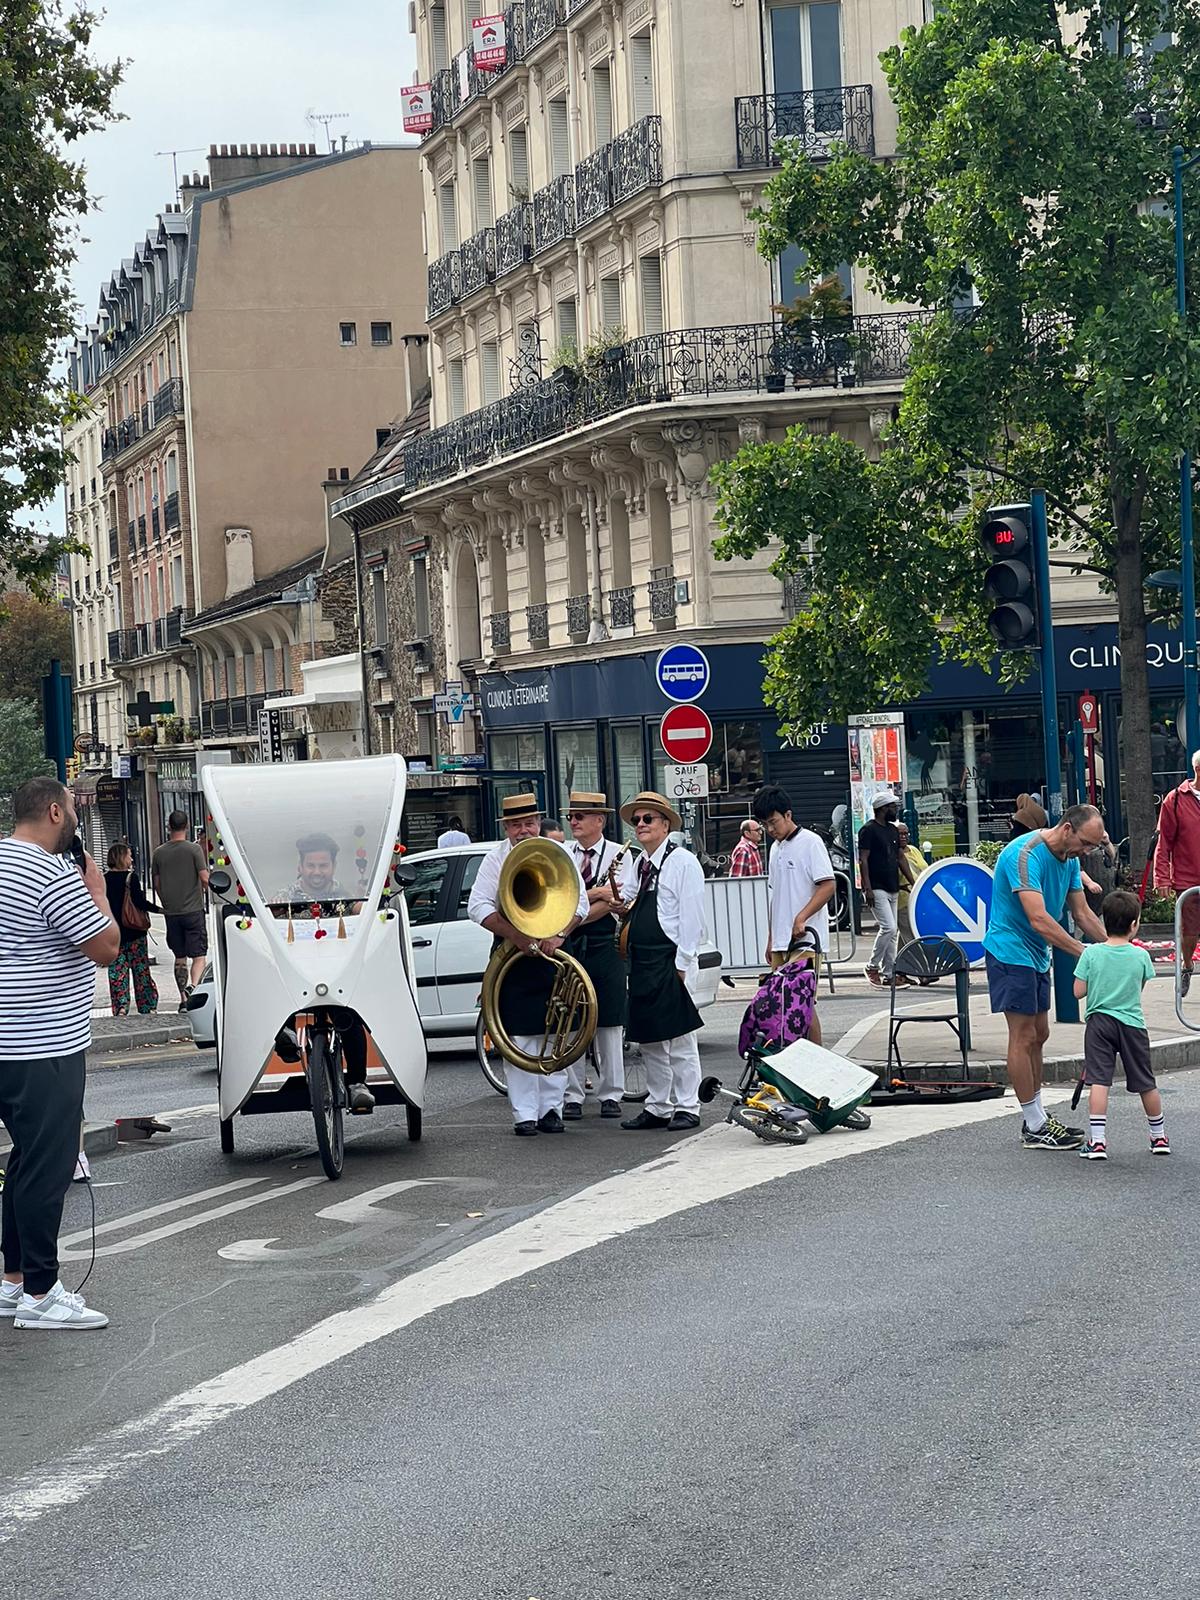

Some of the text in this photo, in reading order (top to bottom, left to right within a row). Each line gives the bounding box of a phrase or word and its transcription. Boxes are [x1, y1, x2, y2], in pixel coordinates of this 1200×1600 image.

[482, 37, 496, 45] ERA
[487, 690, 512, 709] CLINIQUE
[88, 744, 104, 752] BAR
[674, 765, 698, 776] SAUF
